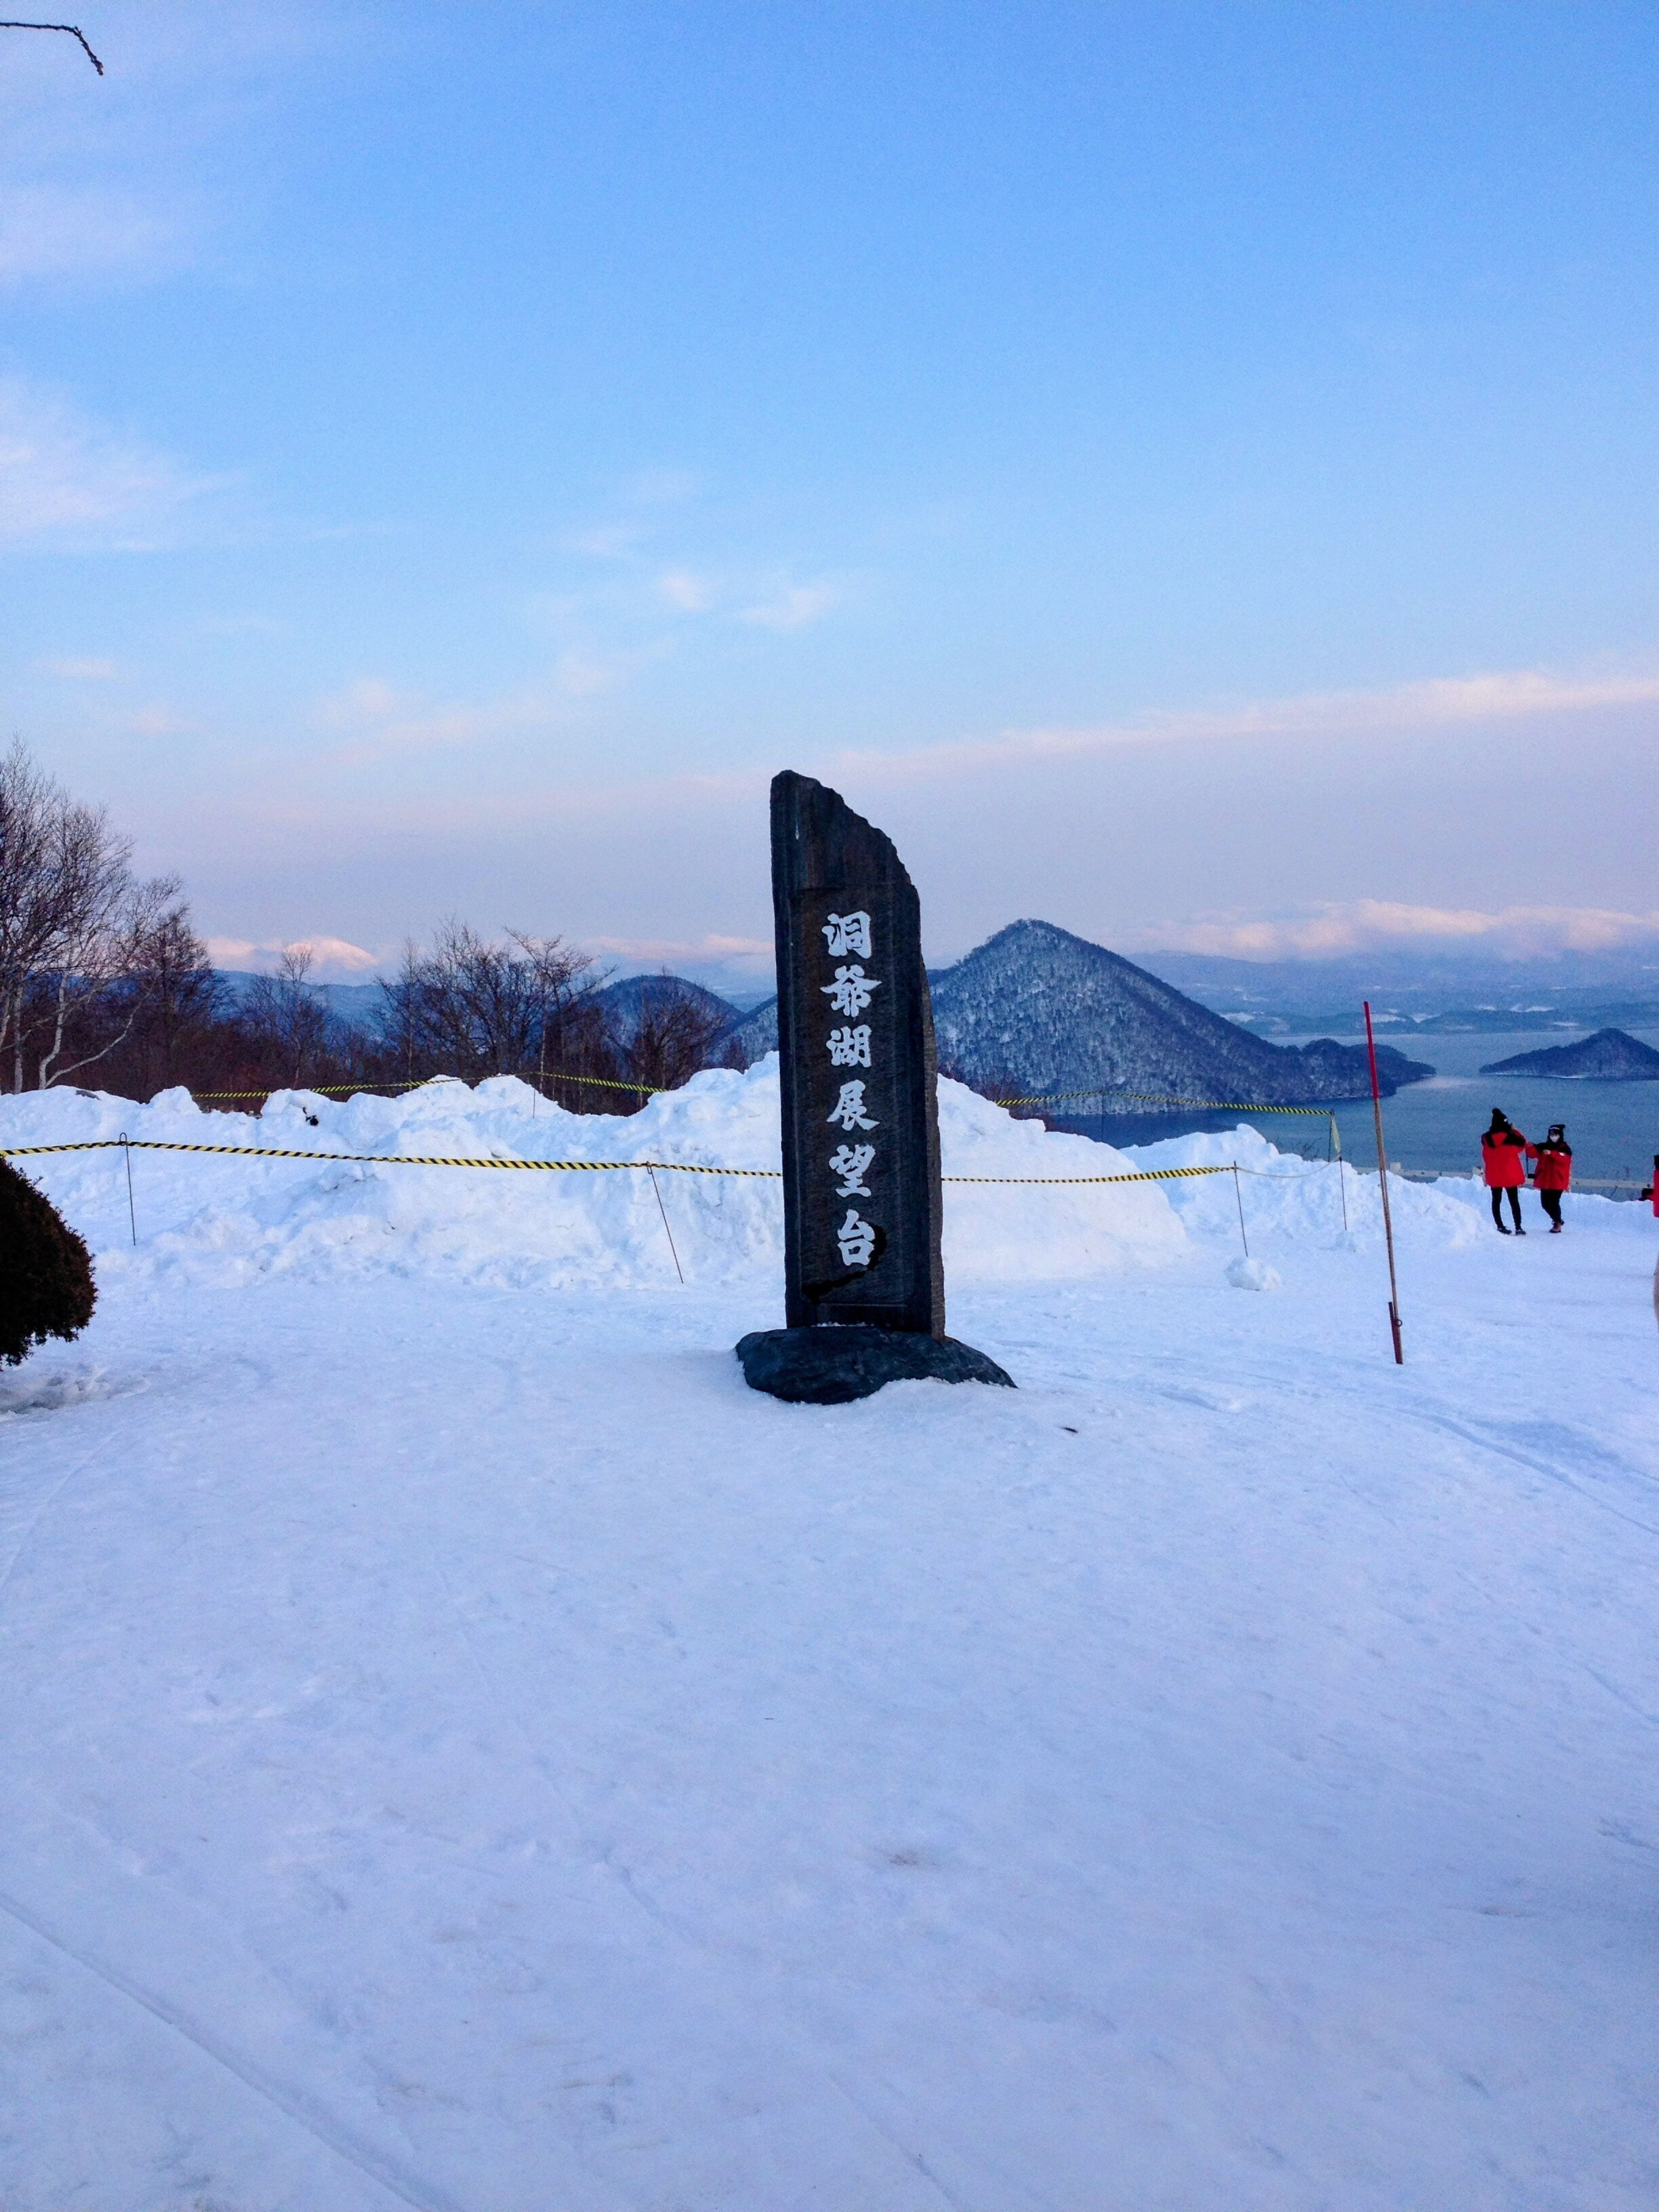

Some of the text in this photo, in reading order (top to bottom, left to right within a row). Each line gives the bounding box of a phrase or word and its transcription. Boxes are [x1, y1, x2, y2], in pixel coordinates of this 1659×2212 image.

[820, 910, 882, 1266] 洞爺湖展望台
